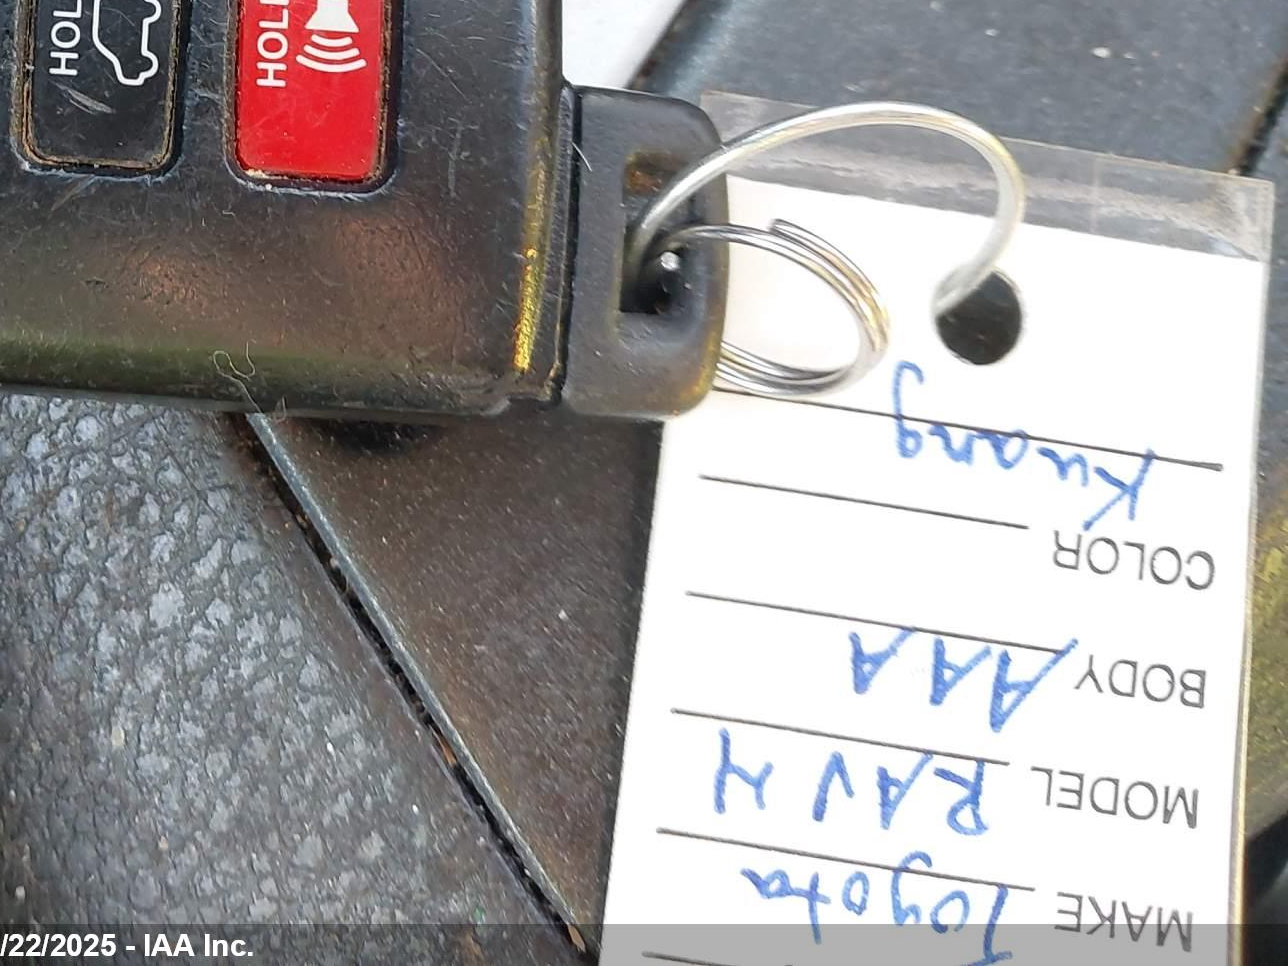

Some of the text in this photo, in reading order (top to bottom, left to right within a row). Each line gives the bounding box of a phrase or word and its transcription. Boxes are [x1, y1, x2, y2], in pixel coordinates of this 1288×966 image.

[1053, 531, 1216, 591] COLOR
[1075, 654, 1207, 709] BODY
[1031, 766, 1199, 829] MODEL
[740, 850, 1013, 964] Toyota
[1054, 892, 1193, 952] MAKE
